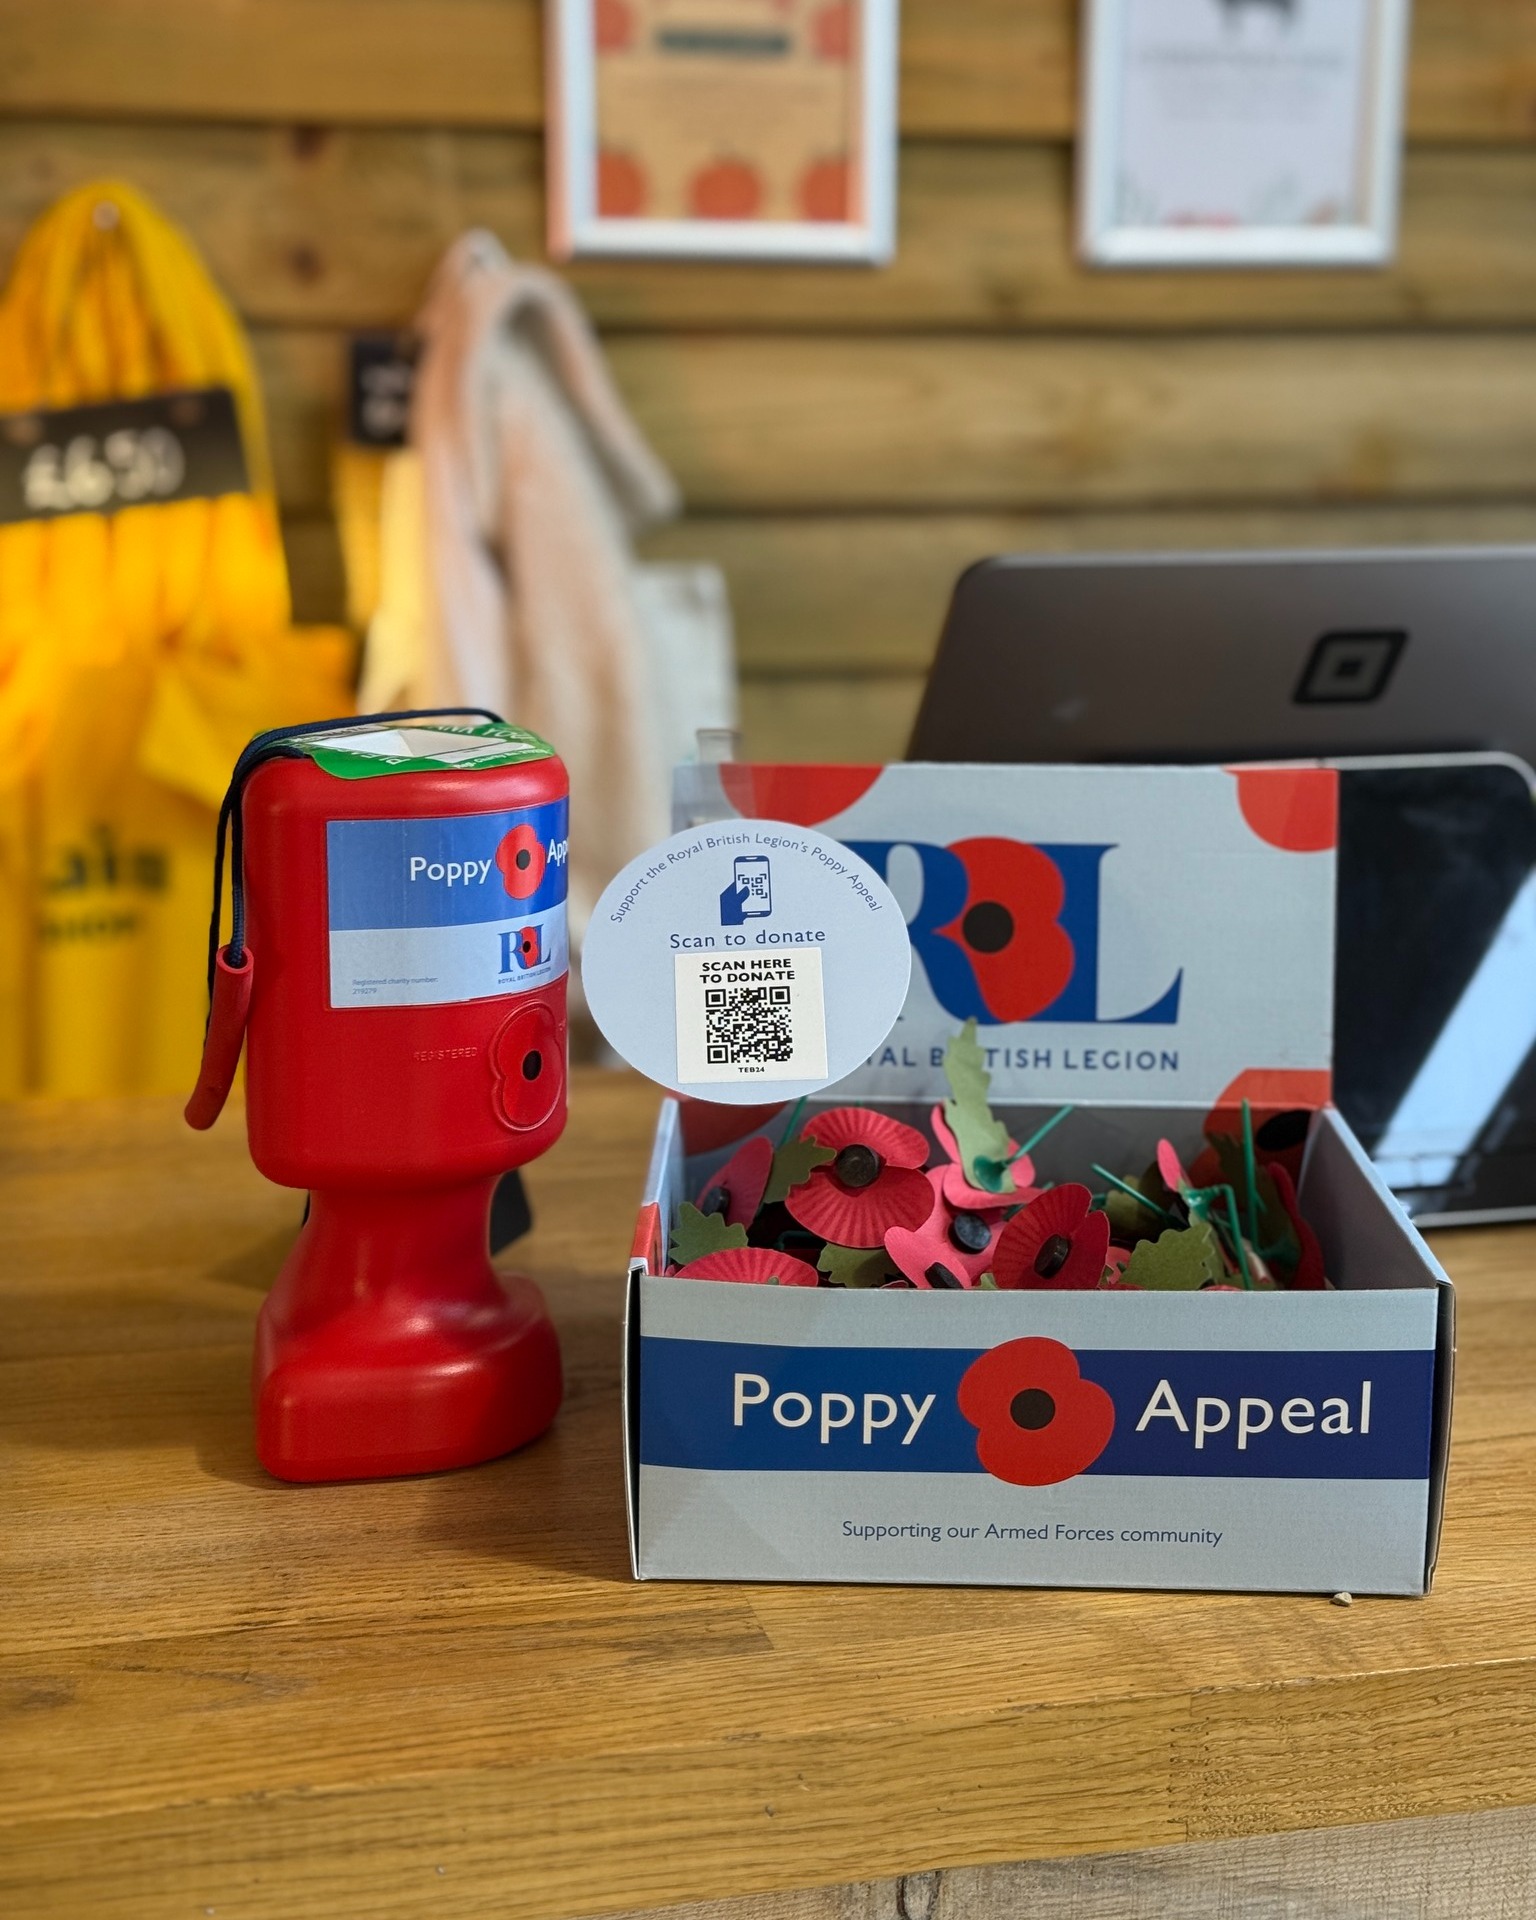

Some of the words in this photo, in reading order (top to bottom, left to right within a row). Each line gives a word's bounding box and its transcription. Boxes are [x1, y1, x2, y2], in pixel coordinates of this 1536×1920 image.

[410, 856, 492, 887] Poppy
[611, 878, 648, 923] Support
[646, 862, 667, 879] the
[667, 841, 703, 864] Royal
[706, 834, 750, 849] British
[755, 833, 809, 853] Legion's
[811, 846, 848, 875] Poppy
[846, 874, 883, 912] Appeal
[670, 933, 715, 949] Scan
[724, 934, 746, 946] to
[755, 930, 826, 944] donate
[700, 974, 722, 984] TO
[727, 970, 796, 983] DONATE
[702, 960, 745, 972] SCAN
[750, 958, 792, 970] HERE
[930, 1047, 1051, 1069] BTISH
[1063, 1049, 1179, 1071] LEGION
[733, 1373, 937, 1446] Poppy
[1134, 1379, 1371, 1452] Appeal
[842, 1520, 942, 1542] Supporting
[947, 1525, 979, 1539] our
[984, 1523, 1048, 1540] Armed
[1055, 1524, 1114, 1542] Forces
[1120, 1527, 1223, 1548] community
